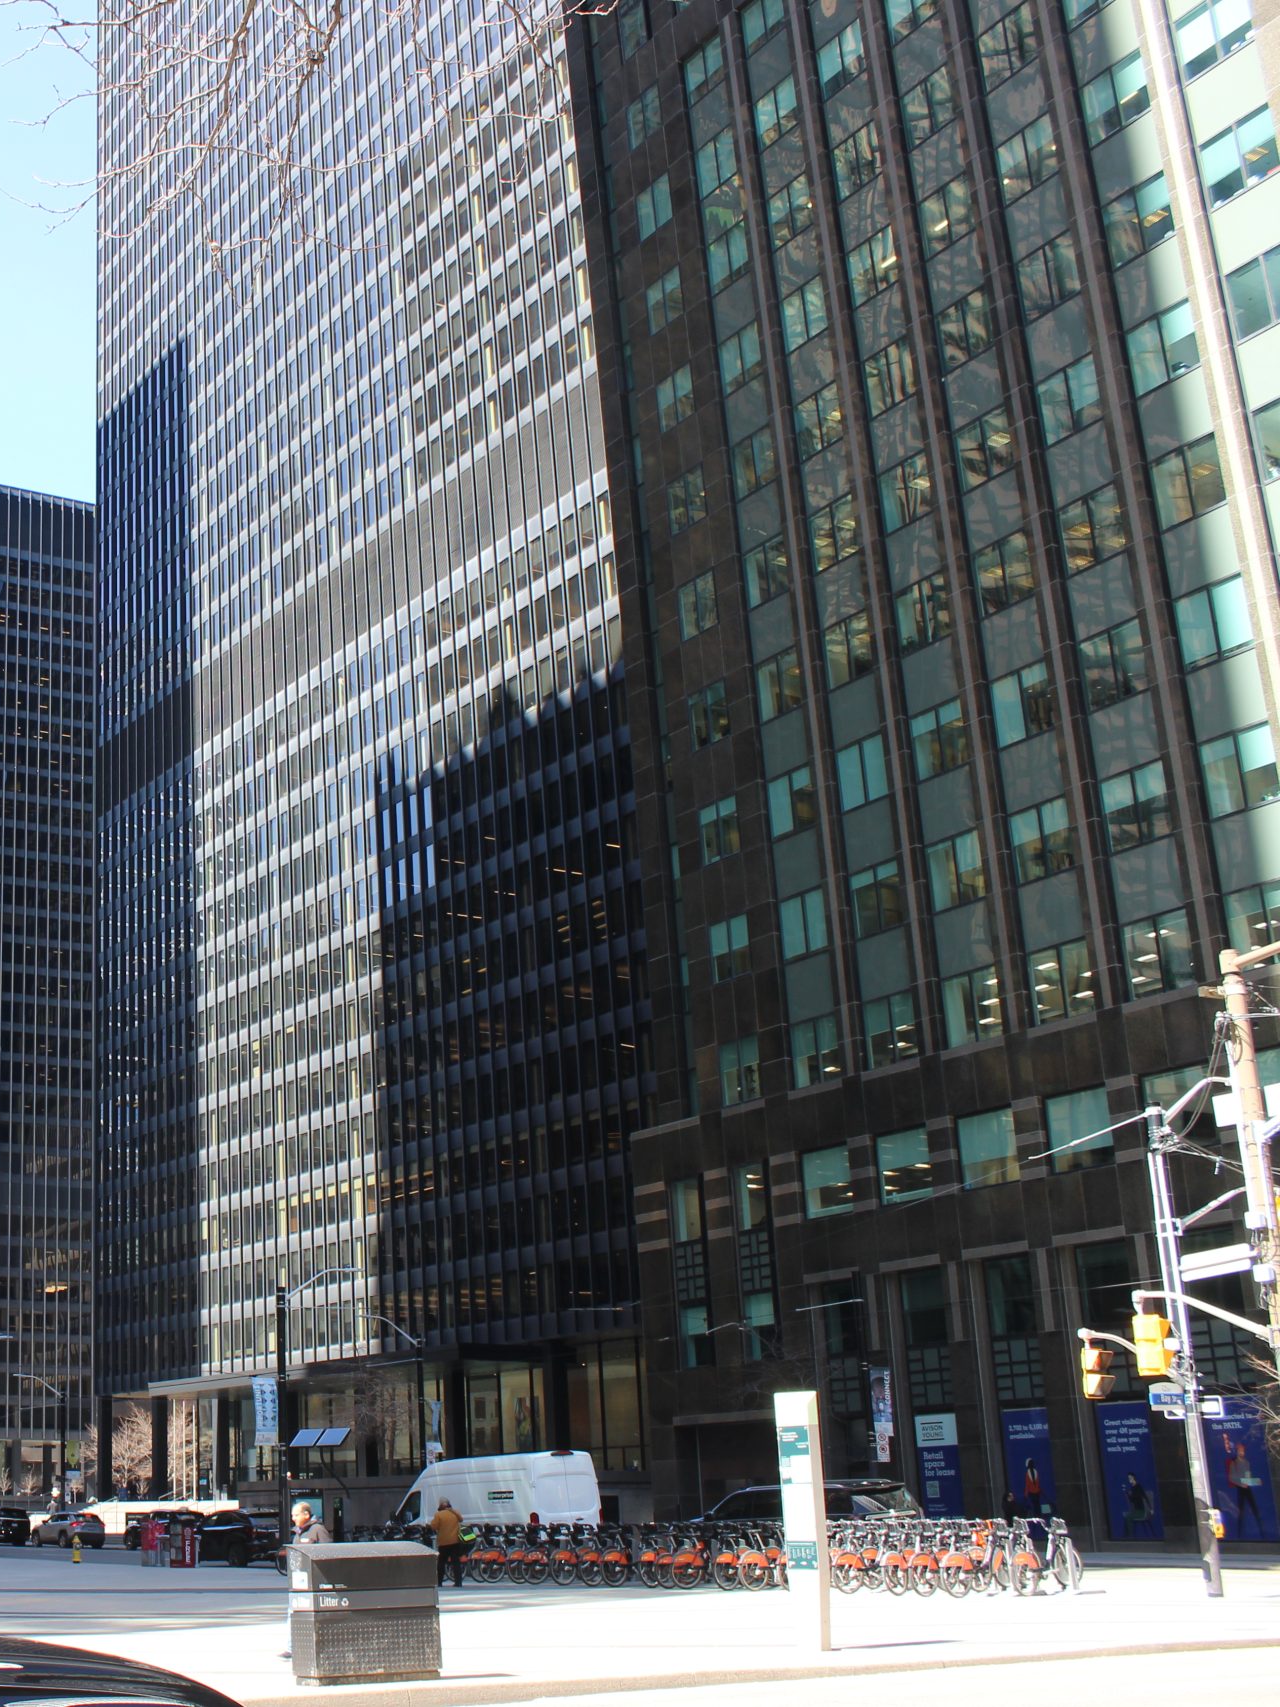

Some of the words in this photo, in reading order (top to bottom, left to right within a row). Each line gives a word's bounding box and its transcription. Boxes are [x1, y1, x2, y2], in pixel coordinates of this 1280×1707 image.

[883, 1370, 891, 1404] CONNECT
[921, 1424, 943, 1432] AVISON
[922, 1431, 944, 1439] YOUNG
[923, 1450, 944, 1460] Retail
[924, 1461, 945, 1470] space
[935, 1467, 956, 1476] lease
[320, 1596, 339, 1607] Litter
